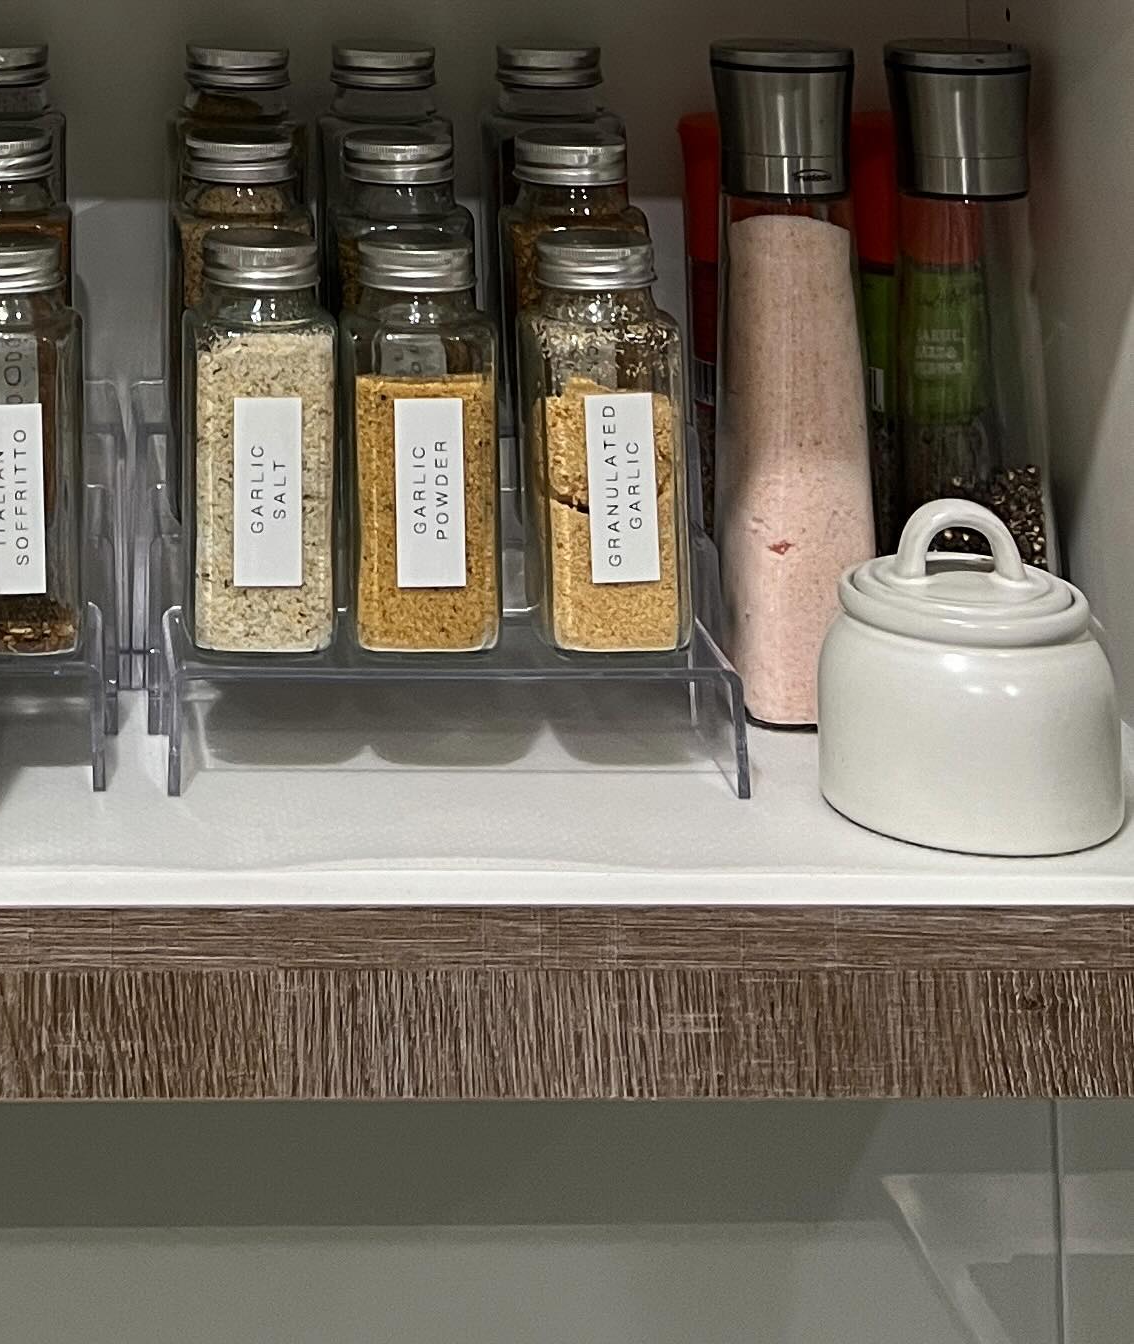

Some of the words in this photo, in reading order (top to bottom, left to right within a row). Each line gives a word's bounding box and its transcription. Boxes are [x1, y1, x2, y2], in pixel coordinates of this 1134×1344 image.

[13, 429, 30, 566] SOFFRITTO
[250, 445, 265, 534] GARLIC
[273, 461, 287, 519] SALT
[412, 446, 426, 534] GARLIC
[434, 440, 449, 540] POWDER
[602, 405, 622, 567] GRANULATED
[626, 441, 643, 530] GARLIC
